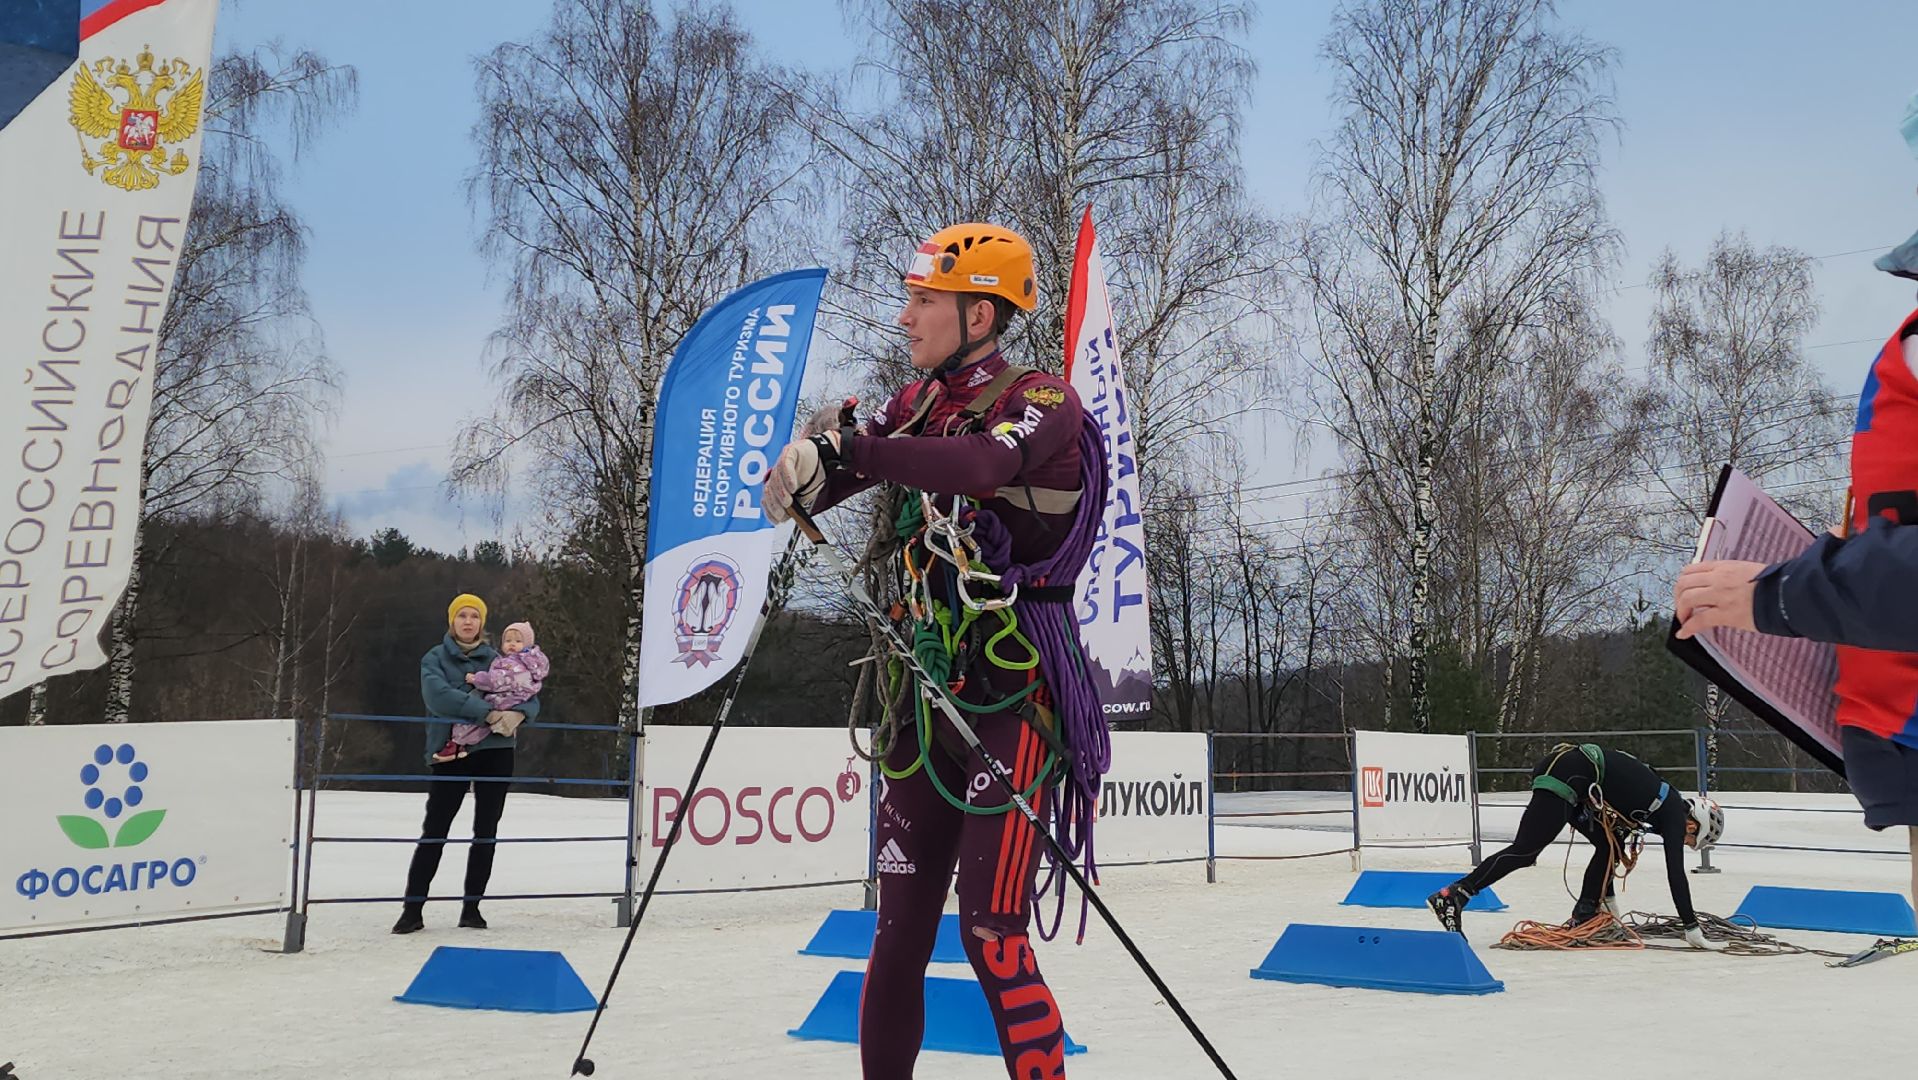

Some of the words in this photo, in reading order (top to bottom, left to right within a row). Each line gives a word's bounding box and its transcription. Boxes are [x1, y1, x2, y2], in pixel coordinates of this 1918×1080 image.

[713, 386, 741, 517] СПОРТИВНОГО
[728, 307, 762, 381] ТУРИЗМА
[731, 304, 796, 520] РОССИИ
[693, 408, 717, 517] ФЕДЕРАЦИЯ
[1099, 772, 1203, 817] ЛУКОЙЛ
[1385, 765, 1466, 803] ЛУКОЙЛ
[651, 786, 835, 847] BOSCO
[16, 857, 197, 900] ФОСАГРО
[877, 860, 916, 874] adidas
[982, 935, 1066, 1080] RUS
